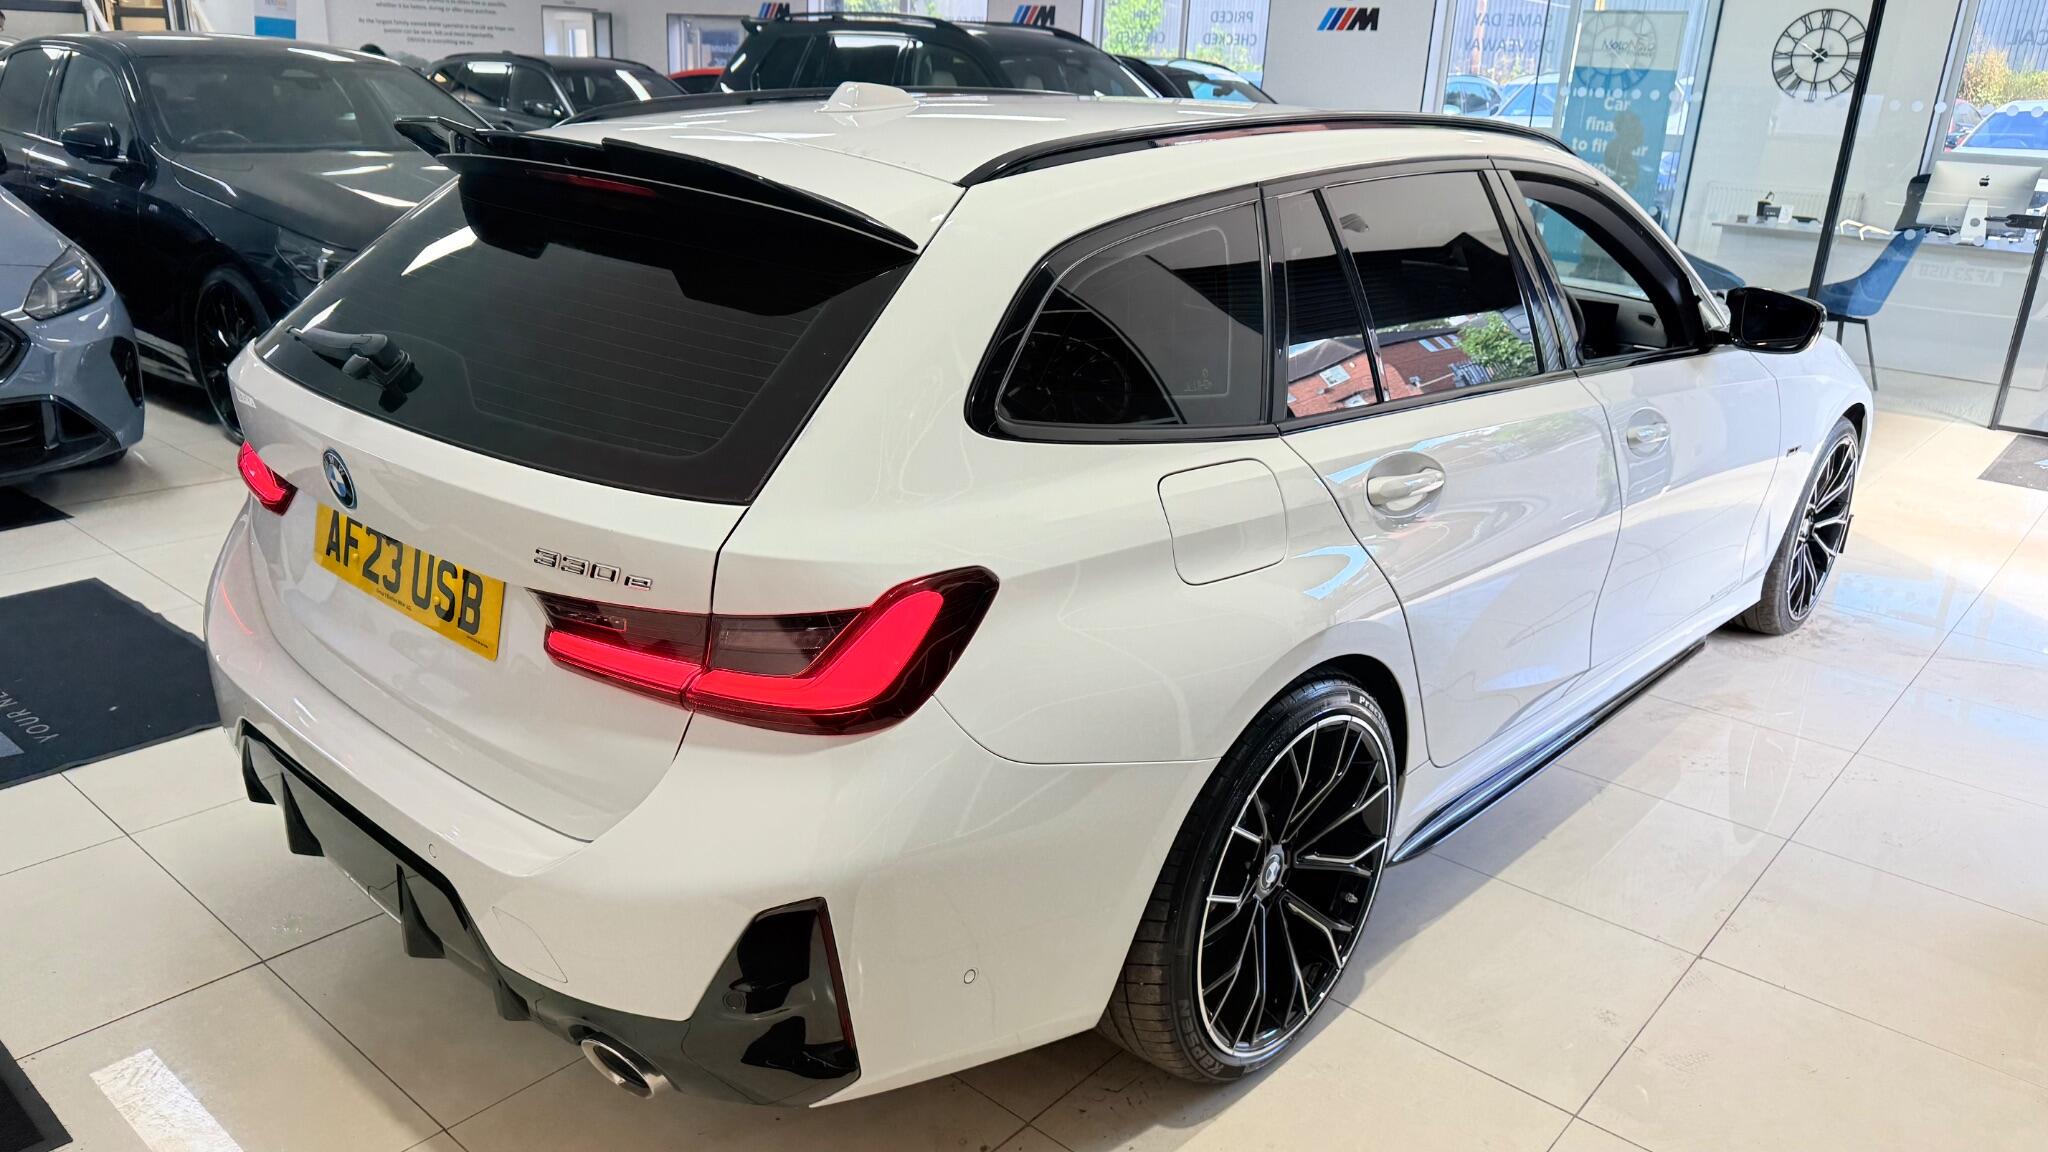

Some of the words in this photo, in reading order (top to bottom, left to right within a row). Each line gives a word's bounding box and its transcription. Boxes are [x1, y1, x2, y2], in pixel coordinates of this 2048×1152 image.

[1603, 96, 1631, 111] Car
[1572, 137, 1588, 151] to
[325, 509, 404, 594] AF23
[411, 547, 484, 636] USB
[7, 708, 60, 744] YOUR
